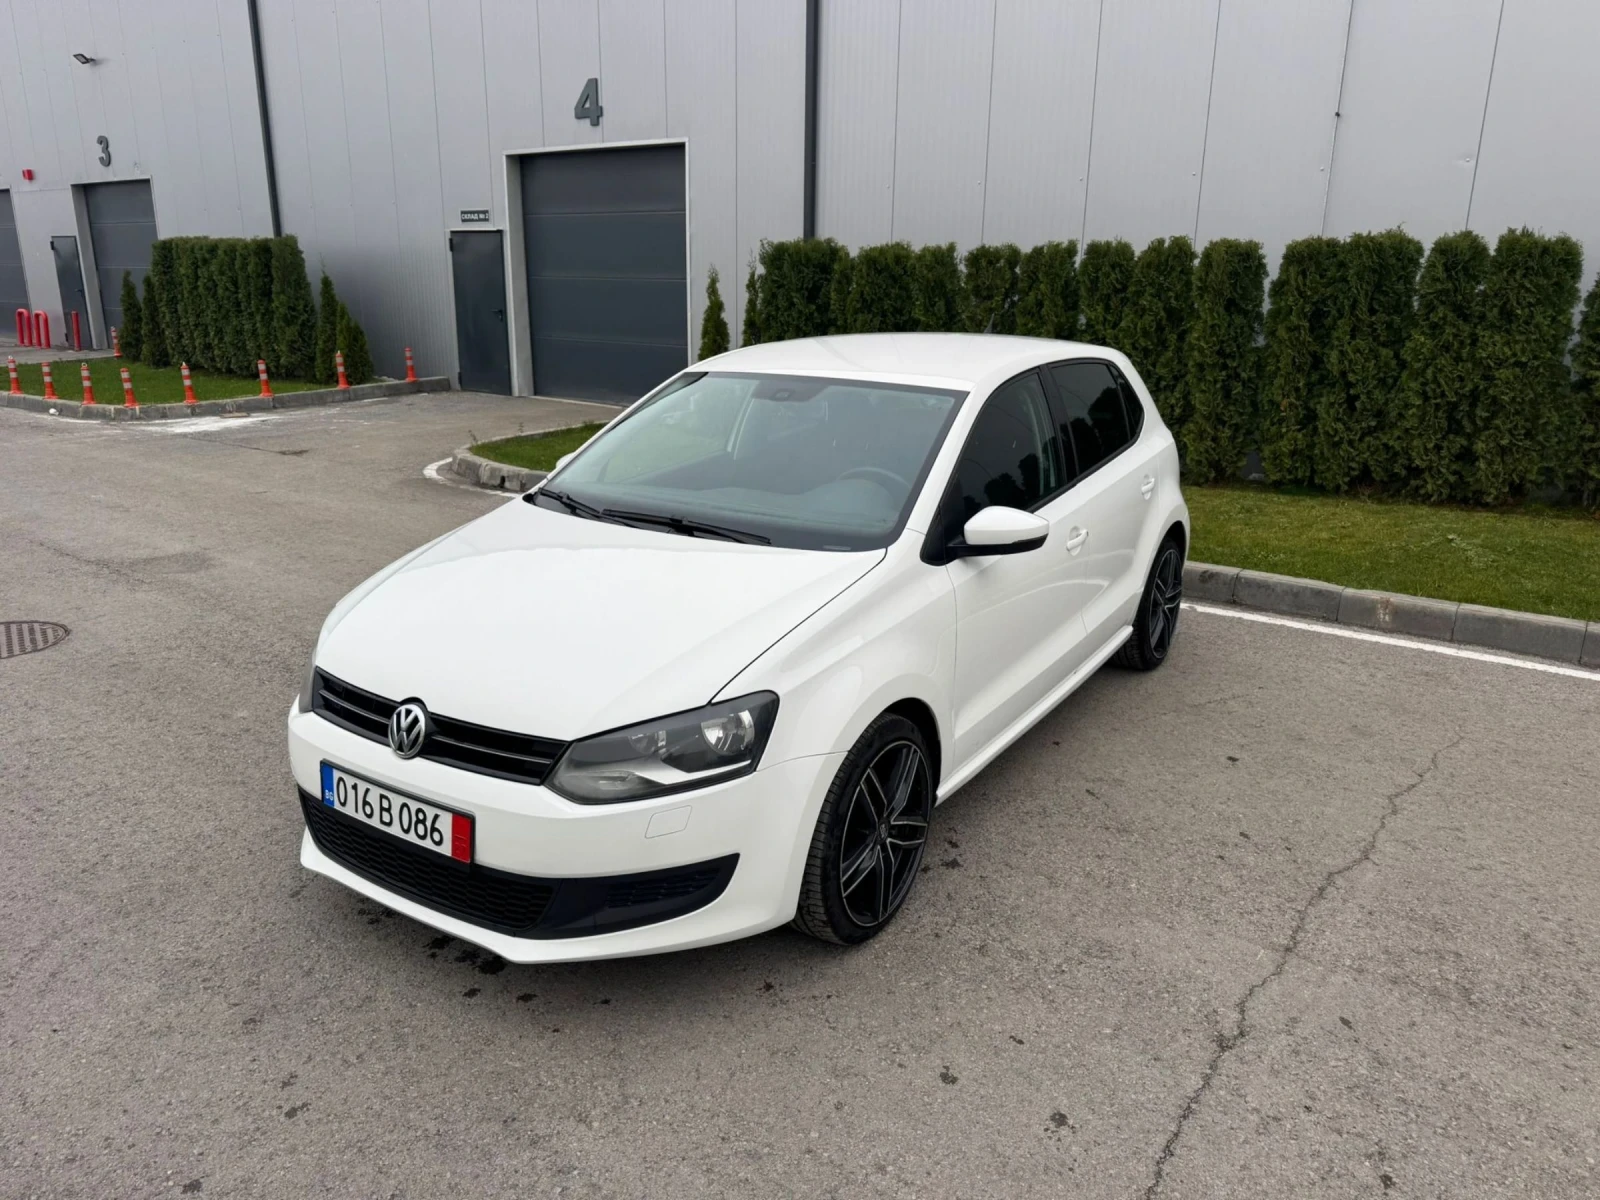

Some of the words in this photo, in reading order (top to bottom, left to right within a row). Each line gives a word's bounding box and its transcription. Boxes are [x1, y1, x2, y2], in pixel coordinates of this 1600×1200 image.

[574, 78, 603, 126] 4
[97, 136, 111, 167] 3
[390, 705, 424, 756] VW
